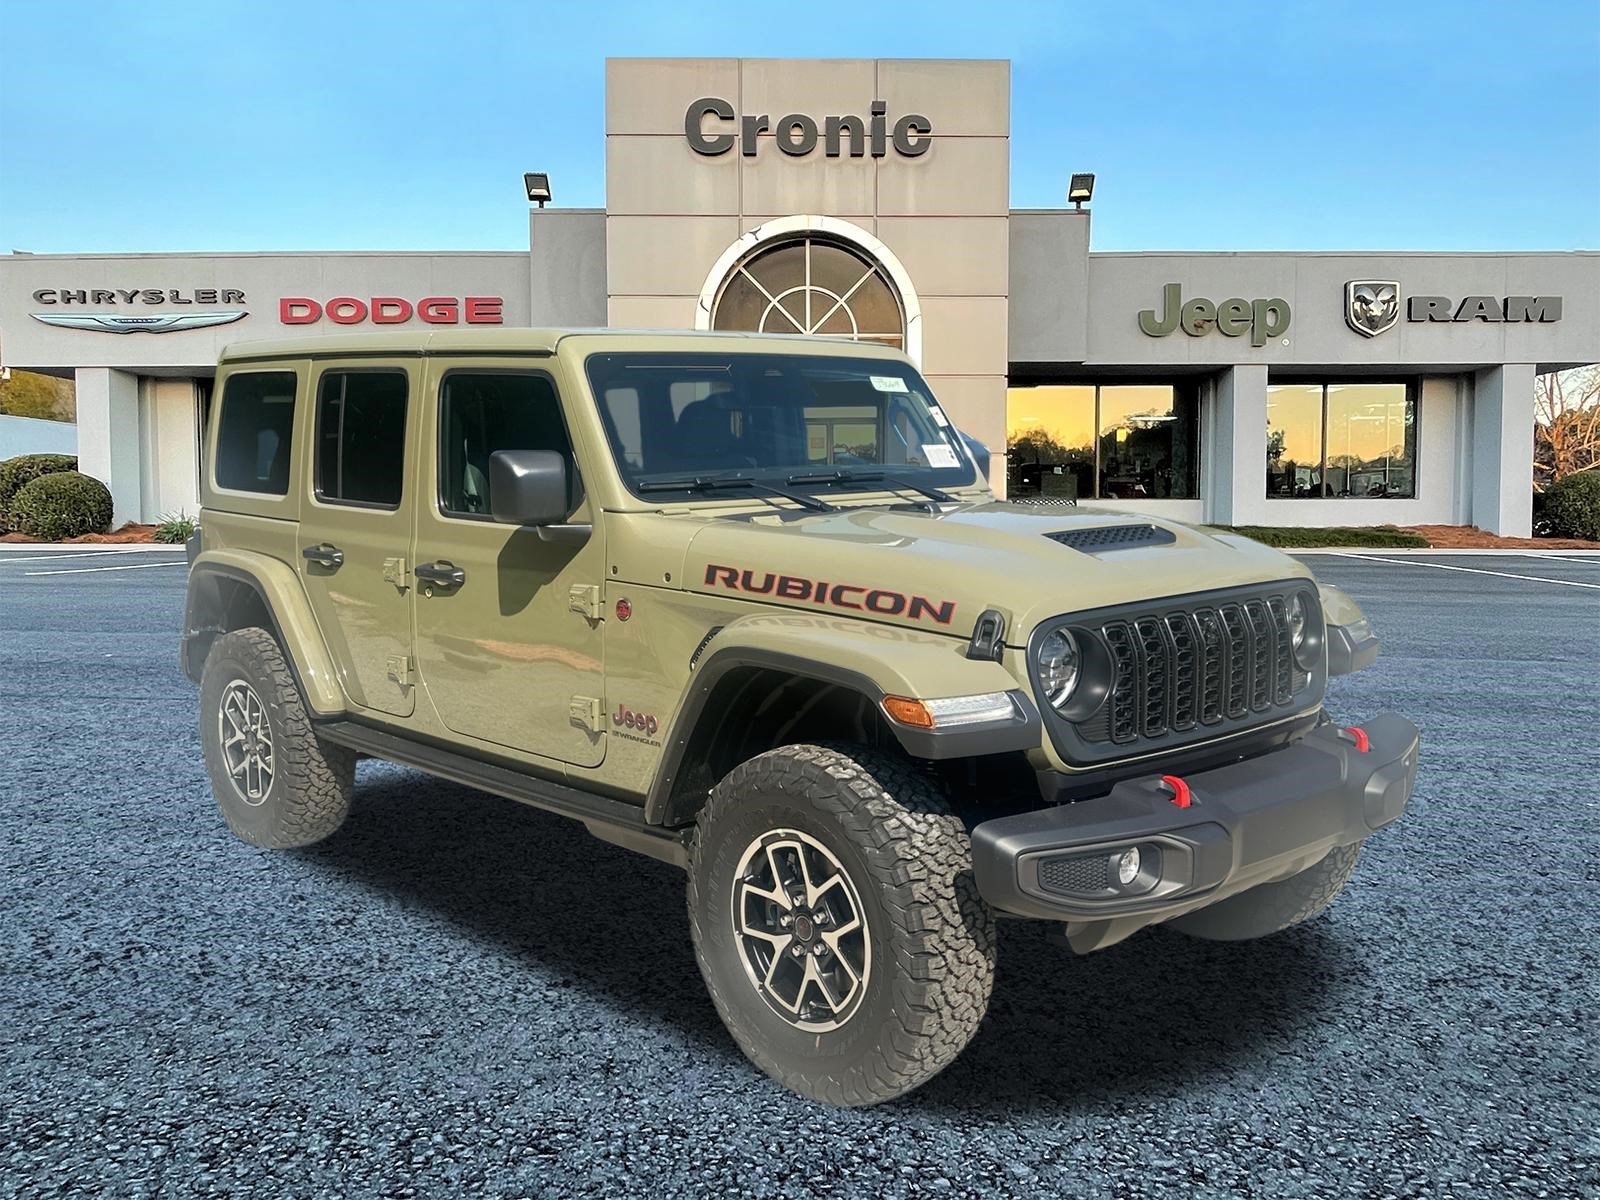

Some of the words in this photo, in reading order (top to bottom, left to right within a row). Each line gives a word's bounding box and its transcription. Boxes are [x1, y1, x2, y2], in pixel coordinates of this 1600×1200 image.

[684, 98, 932, 157] Cronic
[32, 289, 246, 305] CHRYSLER
[279, 297, 503, 324] DODGE
[1407, 296, 1562, 322] RAM
[1138, 283, 1291, 347] Jeep
[704, 563, 957, 625] RUBICON
[612, 703, 659, 737] Jeep
